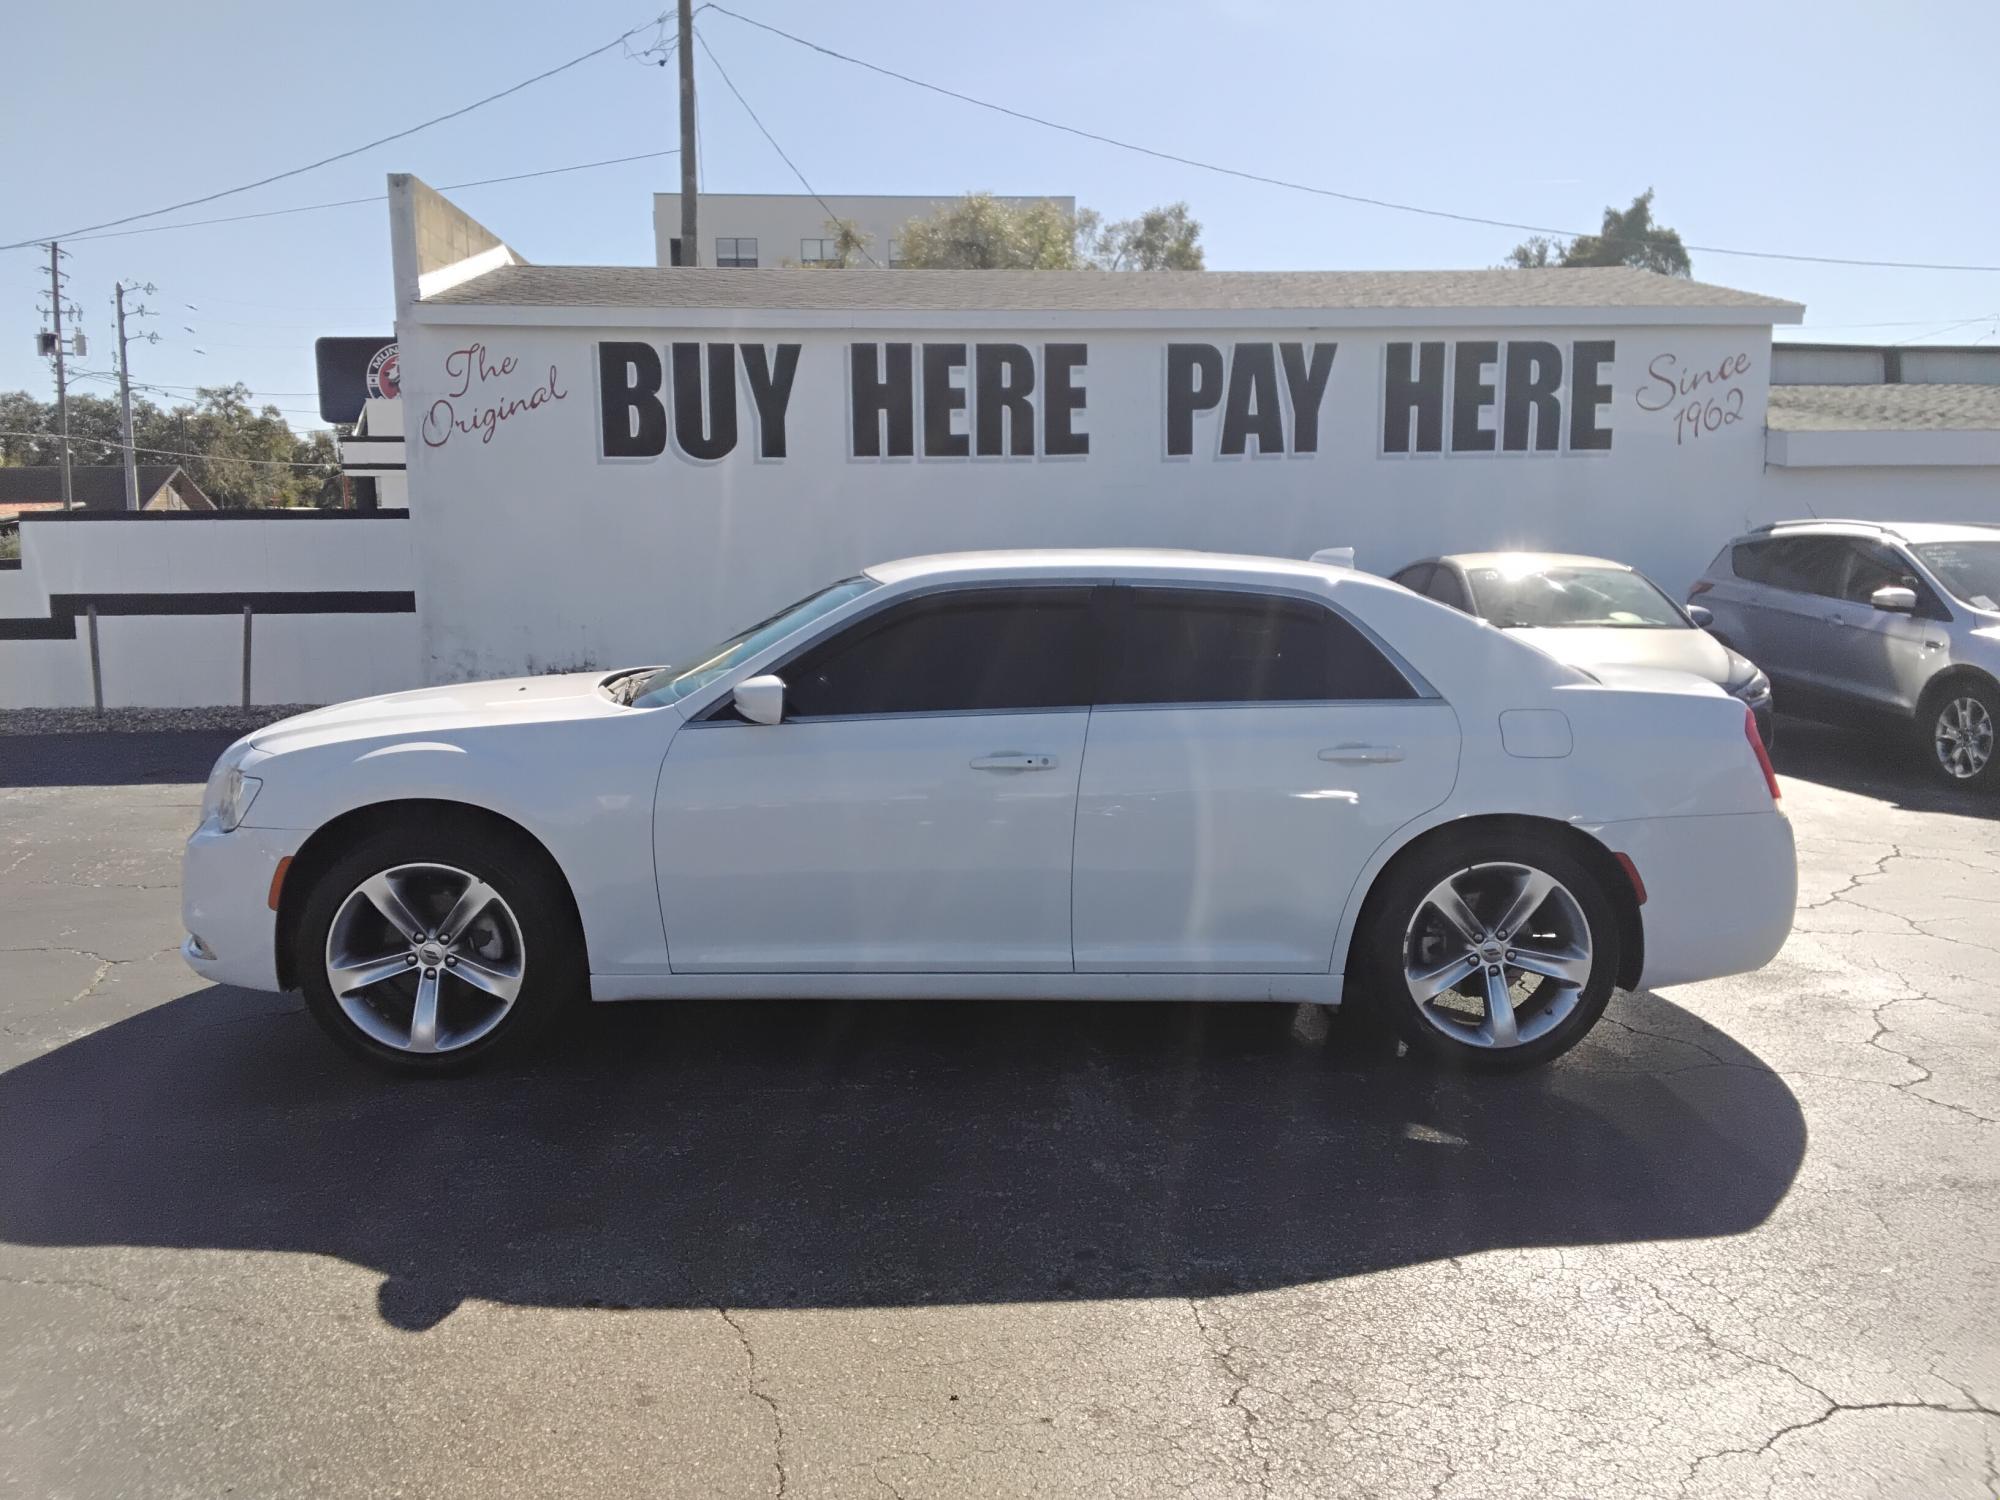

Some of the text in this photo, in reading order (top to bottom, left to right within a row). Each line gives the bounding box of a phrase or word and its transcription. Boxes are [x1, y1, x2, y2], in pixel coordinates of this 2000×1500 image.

[445, 343, 519, 398] The
[598, 340, 1616, 460] BUY HERE PAY HERE
[1635, 352, 1752, 412] Since
[422, 364, 568, 448] Original
[1673, 387, 1744, 446] 1962
